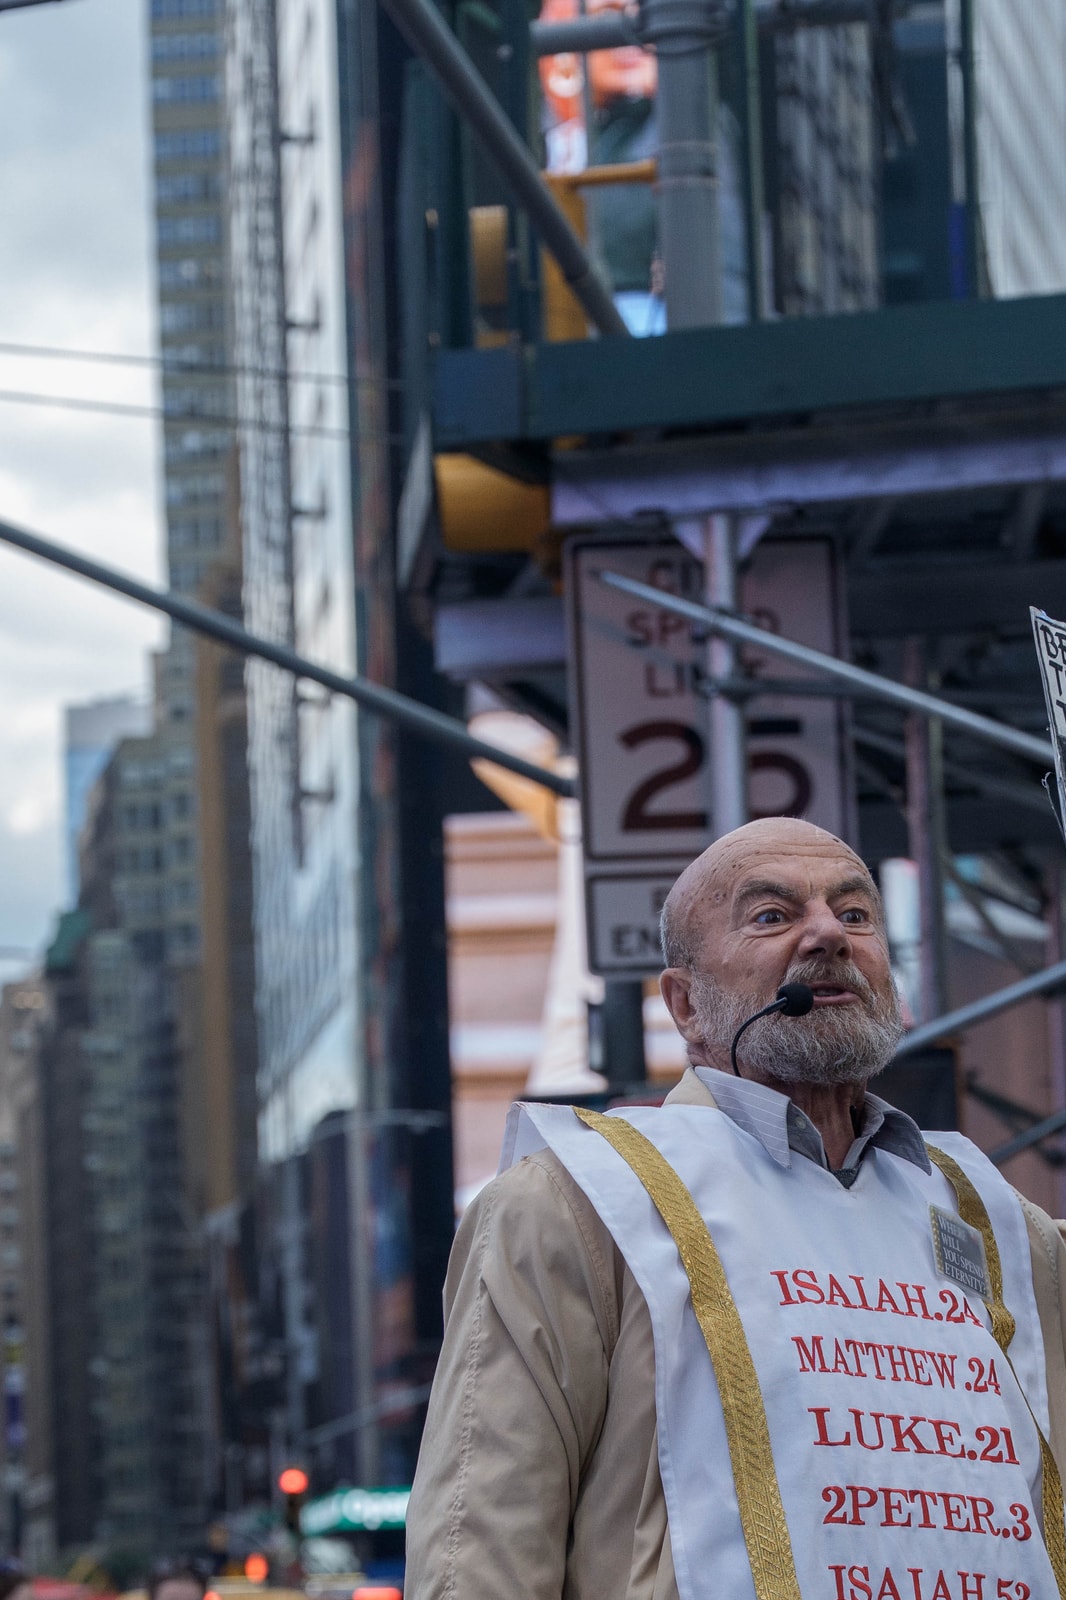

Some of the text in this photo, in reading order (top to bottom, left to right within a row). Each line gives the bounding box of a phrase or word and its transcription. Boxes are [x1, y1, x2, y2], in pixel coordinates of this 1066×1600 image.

[618, 719, 812, 832] 25
[940, 1233, 963, 1253] WILL
[943, 1247, 984, 1278] YOU SPEND
[944, 1262, 987, 1295] ETERNITY?
[807, 1407, 1021, 1466] LUKE.21
[821, 1485, 1032, 1541] 2PETER.3
